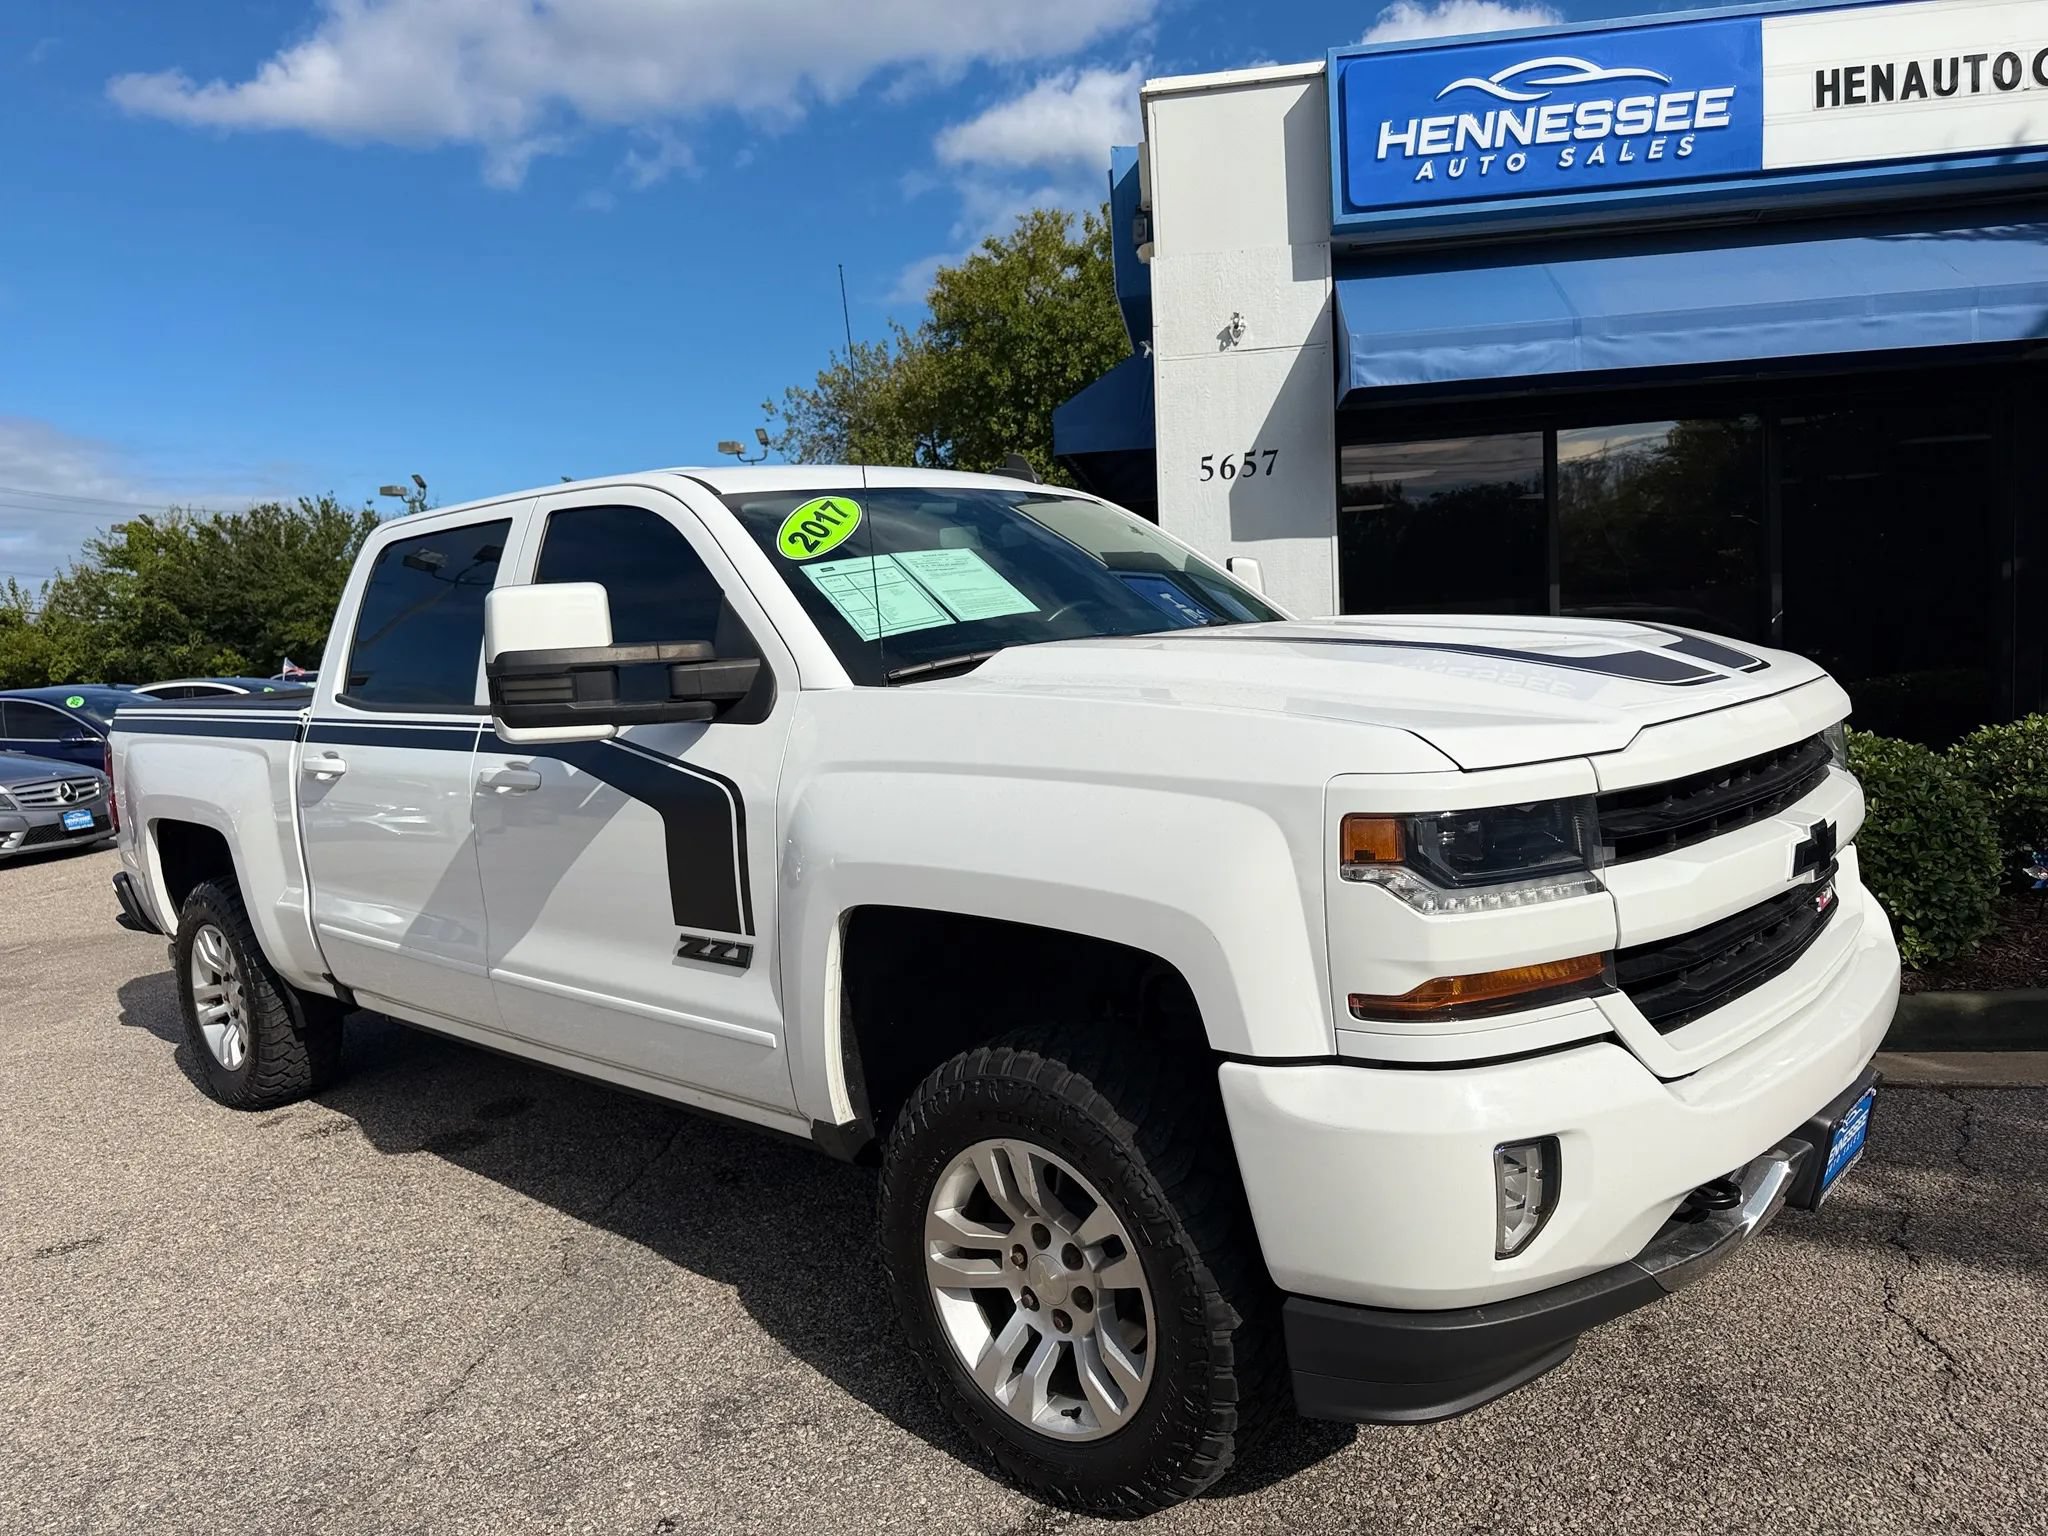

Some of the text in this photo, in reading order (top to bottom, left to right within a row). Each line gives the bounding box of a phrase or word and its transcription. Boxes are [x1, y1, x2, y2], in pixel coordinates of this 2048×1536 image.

[1376, 84, 1737, 160] HENNESSEE
[1414, 133, 1696, 182] AUTO SALES
[1199, 449, 1279, 482] 5657
[787, 500, 850, 555] 2017
